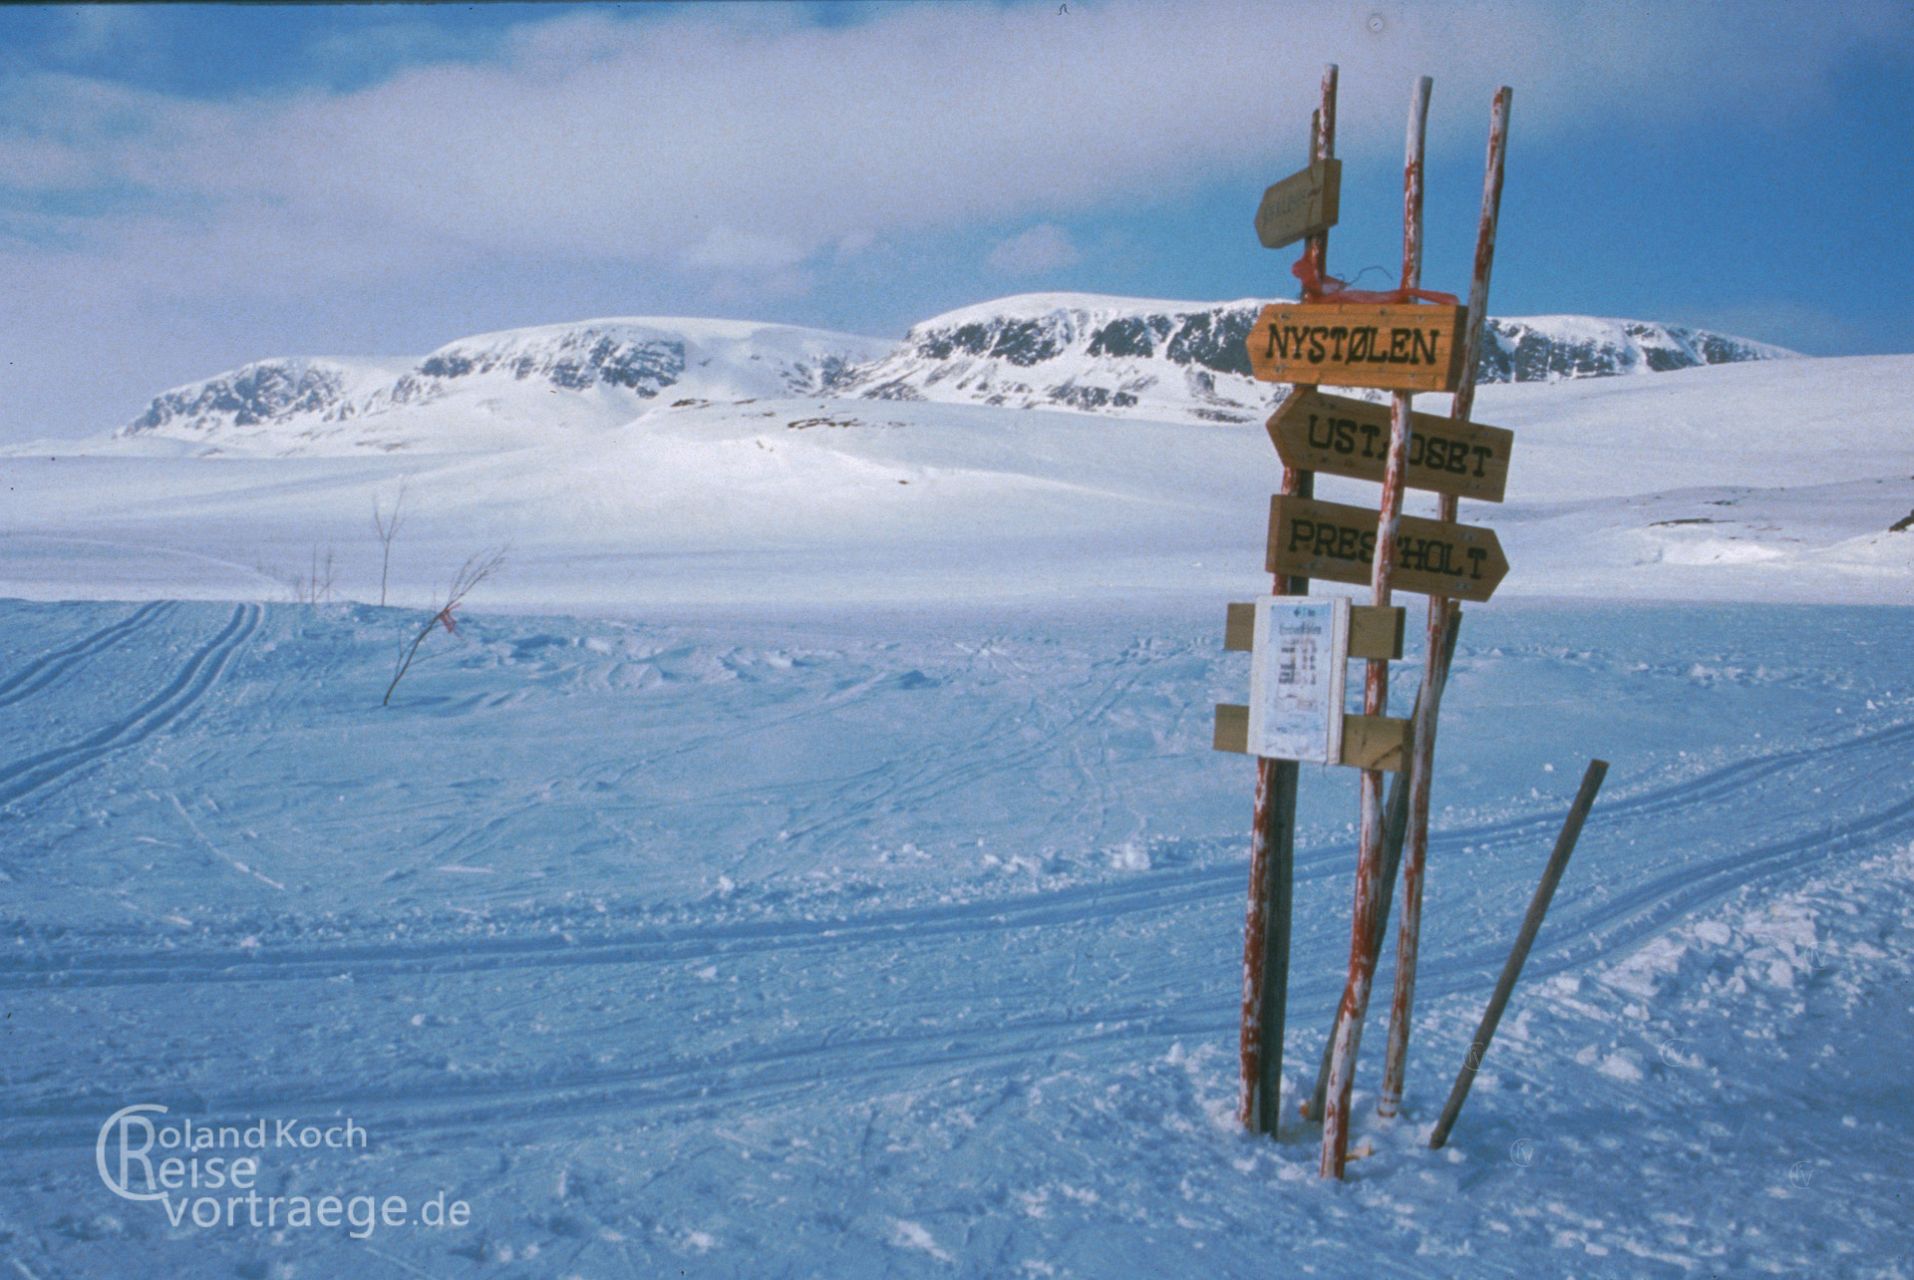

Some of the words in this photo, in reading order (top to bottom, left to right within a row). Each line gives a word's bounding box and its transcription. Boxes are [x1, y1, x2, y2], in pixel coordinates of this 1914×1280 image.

[1265, 323, 1439, 365] NYSTØLEN
[1308, 414, 1492, 478] USTOSET
[1288, 518, 1487, 579] PRESHOLT
